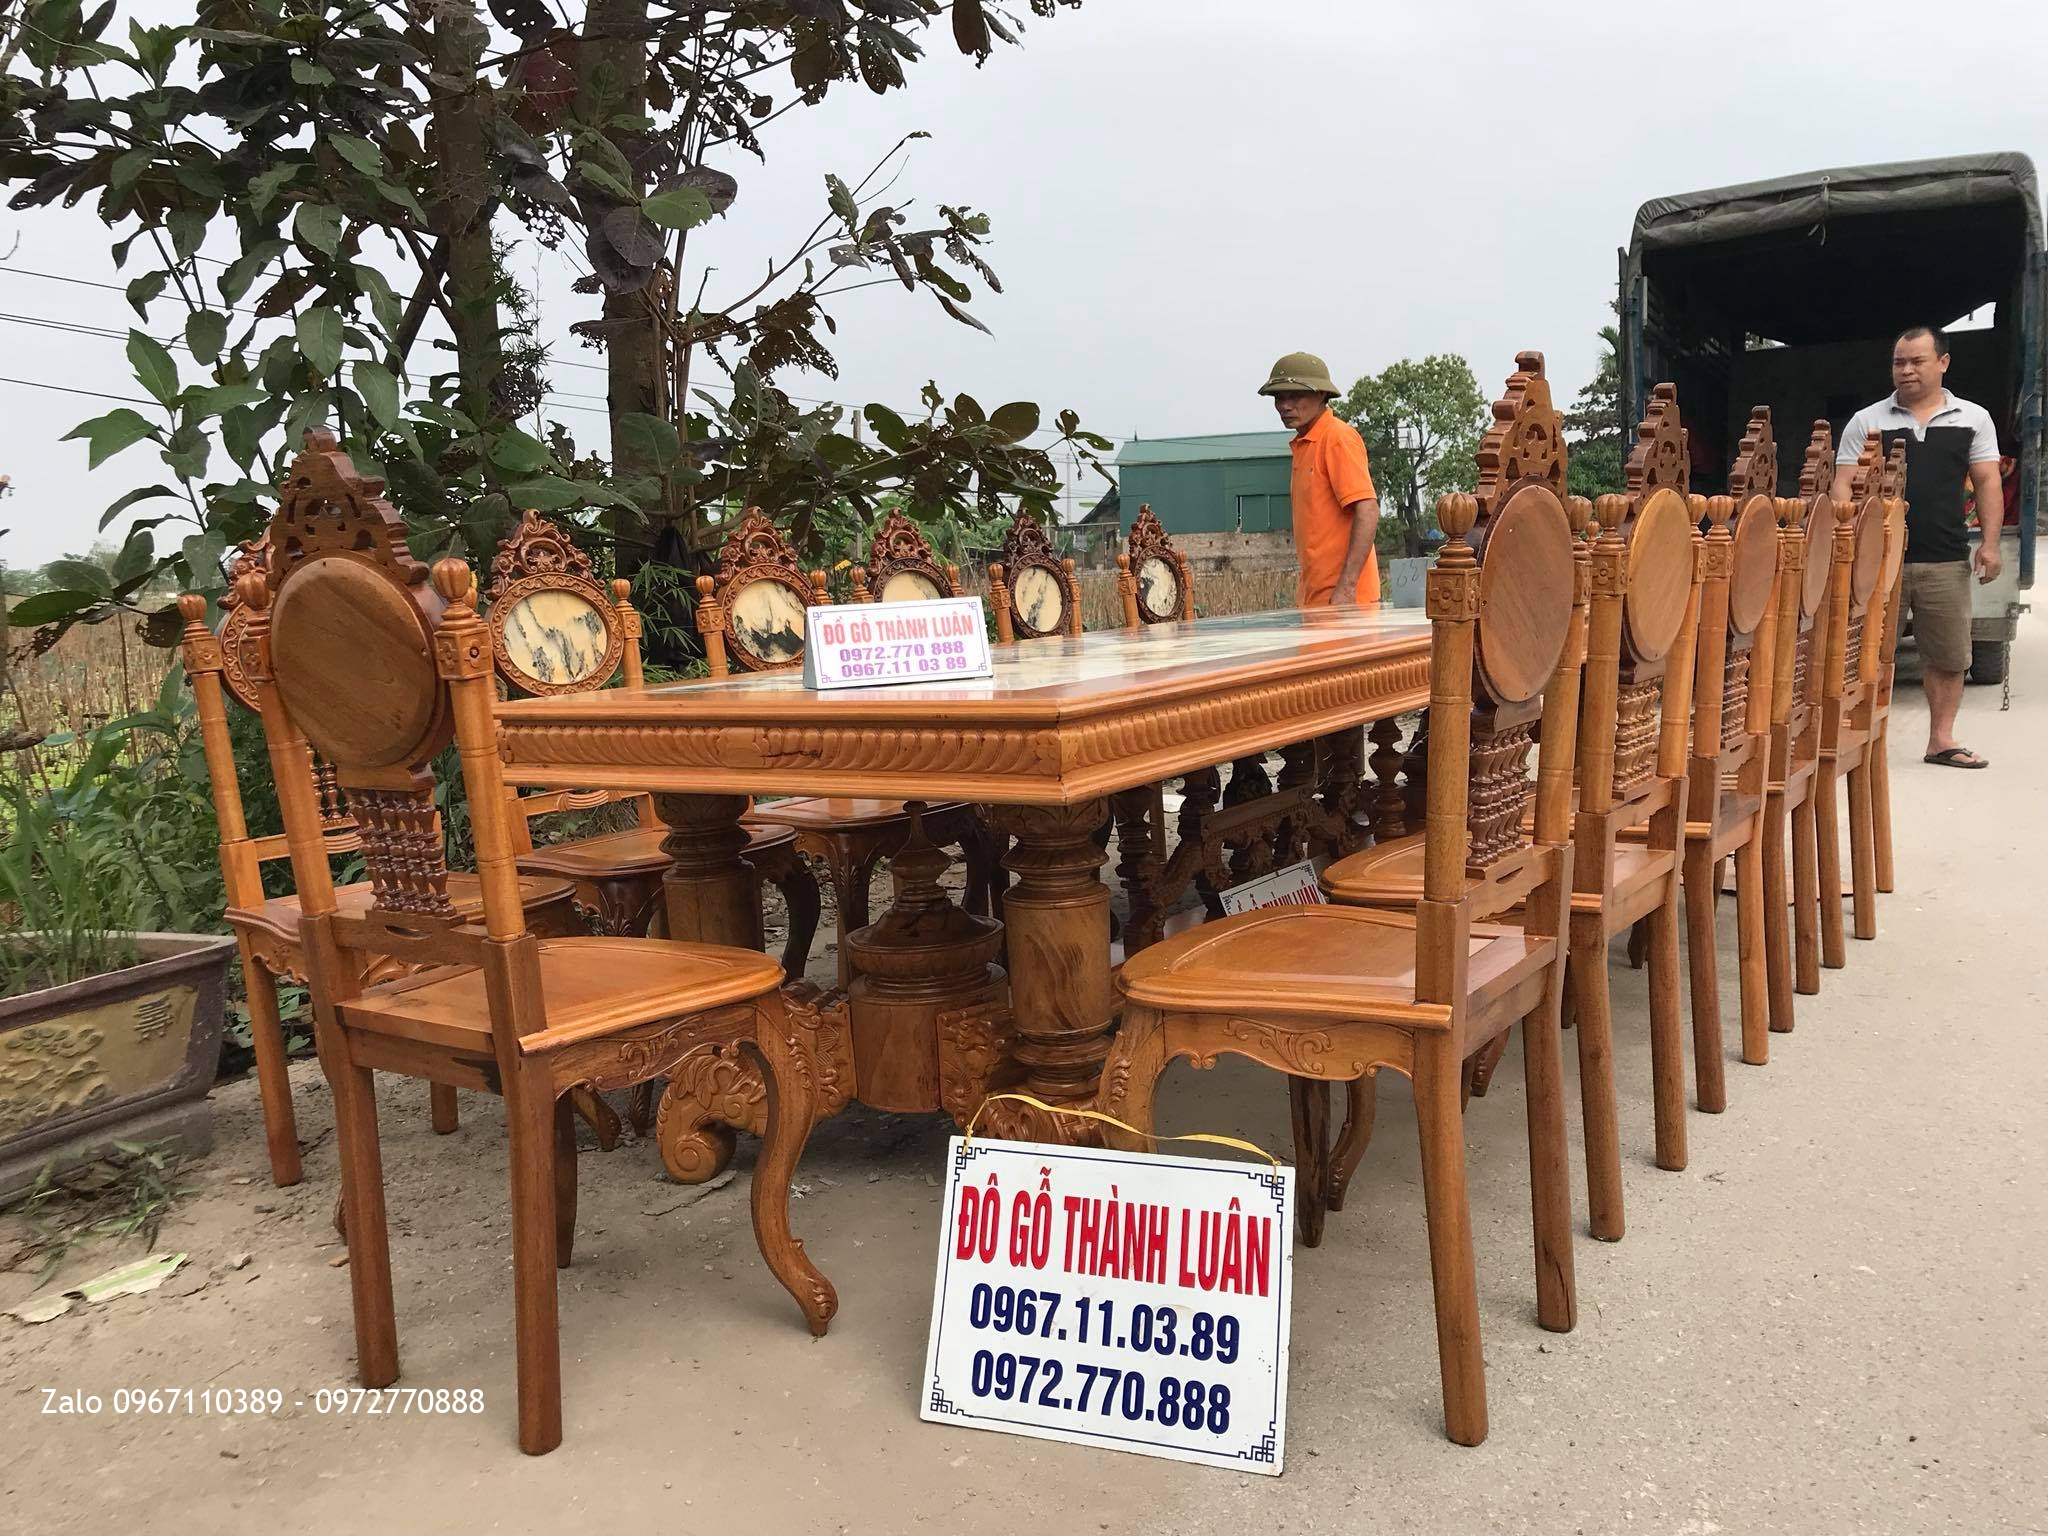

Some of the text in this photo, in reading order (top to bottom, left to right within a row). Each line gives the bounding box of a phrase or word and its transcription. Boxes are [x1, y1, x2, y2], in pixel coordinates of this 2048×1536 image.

[839, 640, 965, 662] 0972.770 888
[876, 615, 929, 641] THÀNH
[931, 611, 974, 638] LUÂN
[841, 656, 968, 678] 0967.11 03 89
[1008, 1167, 1053, 1270] GỖ
[1063, 1184, 1169, 1285] THÀNH
[1178, 1196, 1272, 1298] LUÂN
[969, 1282, 1240, 1365] 0967.11.03.89
[971, 1349, 1231, 1435] 0972.770.888
